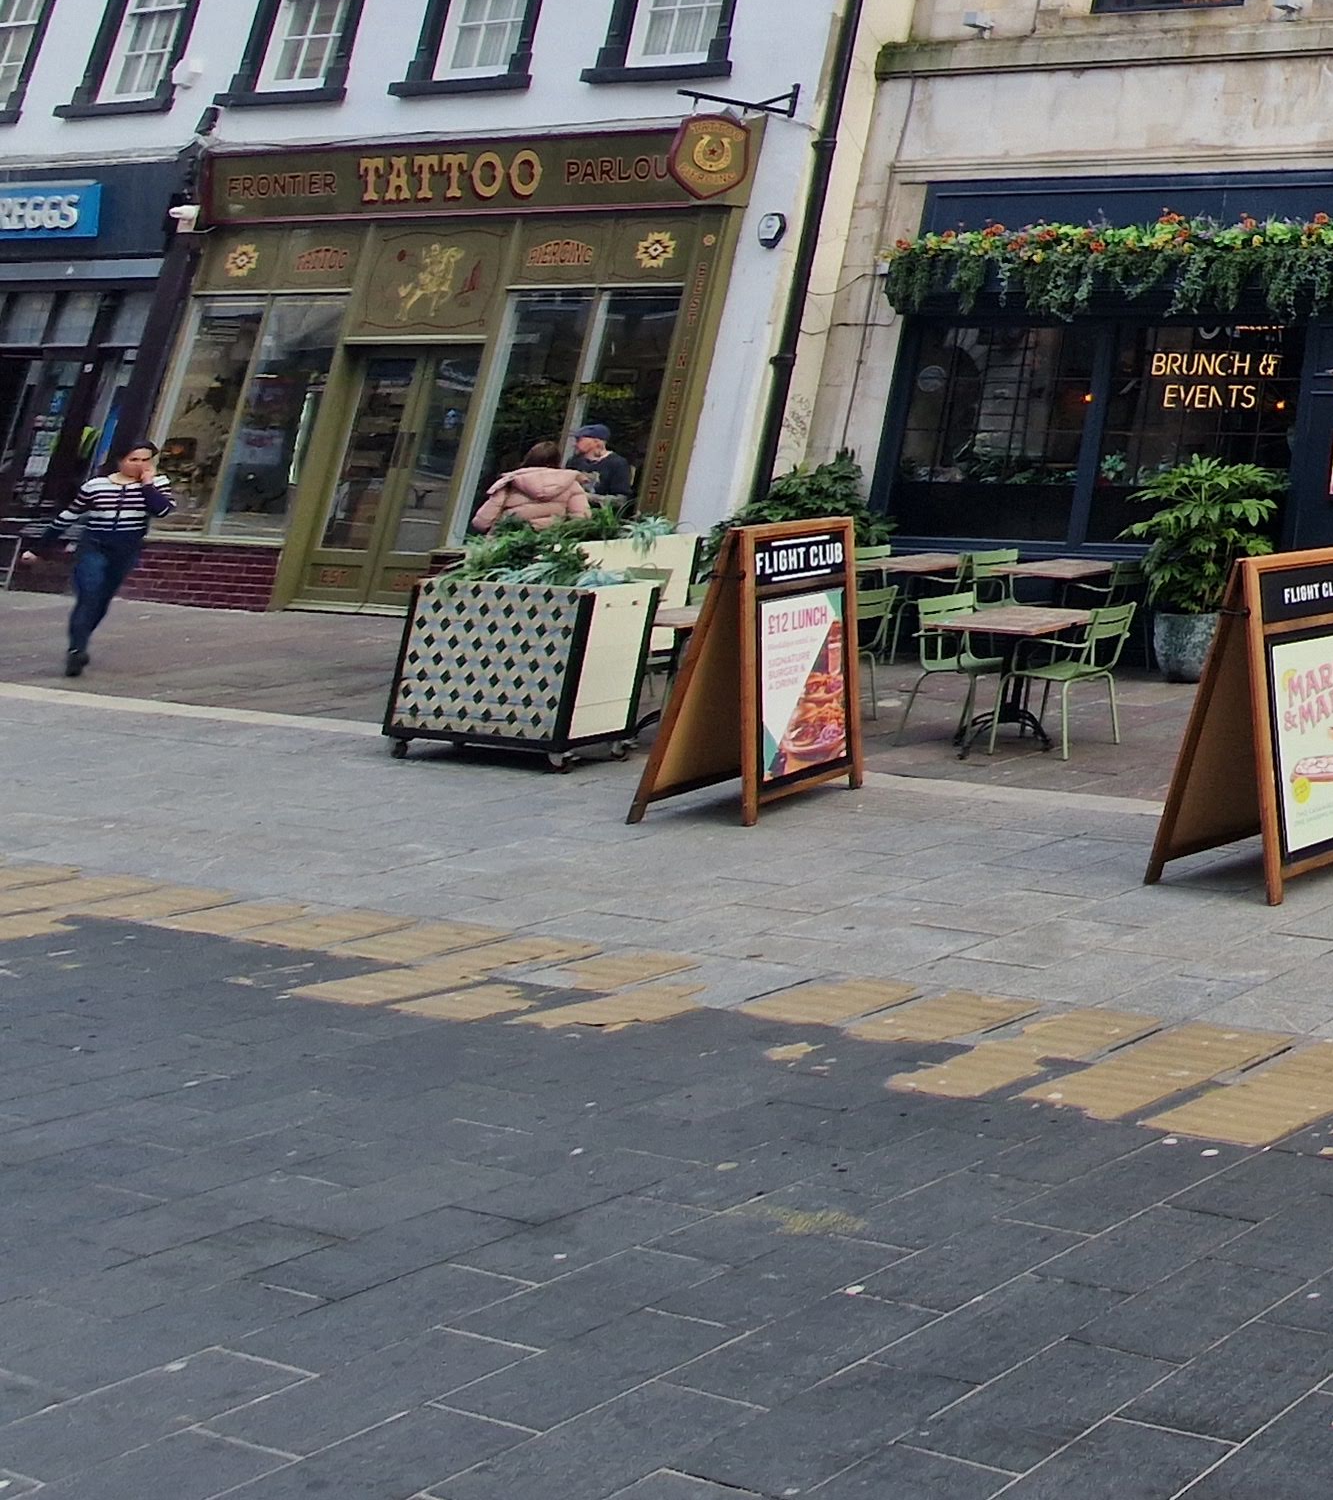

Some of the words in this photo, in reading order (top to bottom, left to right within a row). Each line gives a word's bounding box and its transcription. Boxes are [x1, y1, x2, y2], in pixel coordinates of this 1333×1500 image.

[690, 121, 745, 142] TATTOO
[227, 171, 337, 199] FRONTIER
[359, 149, 543, 203] TATTOO
[564, 154, 669, 185] PARLOU
[526, 239, 595, 267] PIERCING
[688, 261, 708, 326] BEST
[676, 336, 690, 370] IN
[1151, 353, 1251, 377] BRUNCH
[1258, 353, 1279, 377] &
[664, 379, 682, 429] THE
[1162, 384, 1257, 409] EVENTS
[649, 439, 670, 505] WEST
[755, 546, 806, 576] FLIGHT
[809, 541, 844, 568] CLUB
[1284, 582, 1321, 605] FLIGHT
[768, 614, 789, 636] £12
[791, 604, 828, 632] LUNCH
[768, 664, 799, 681] BURGER
[1284, 709, 1298, 732] &
